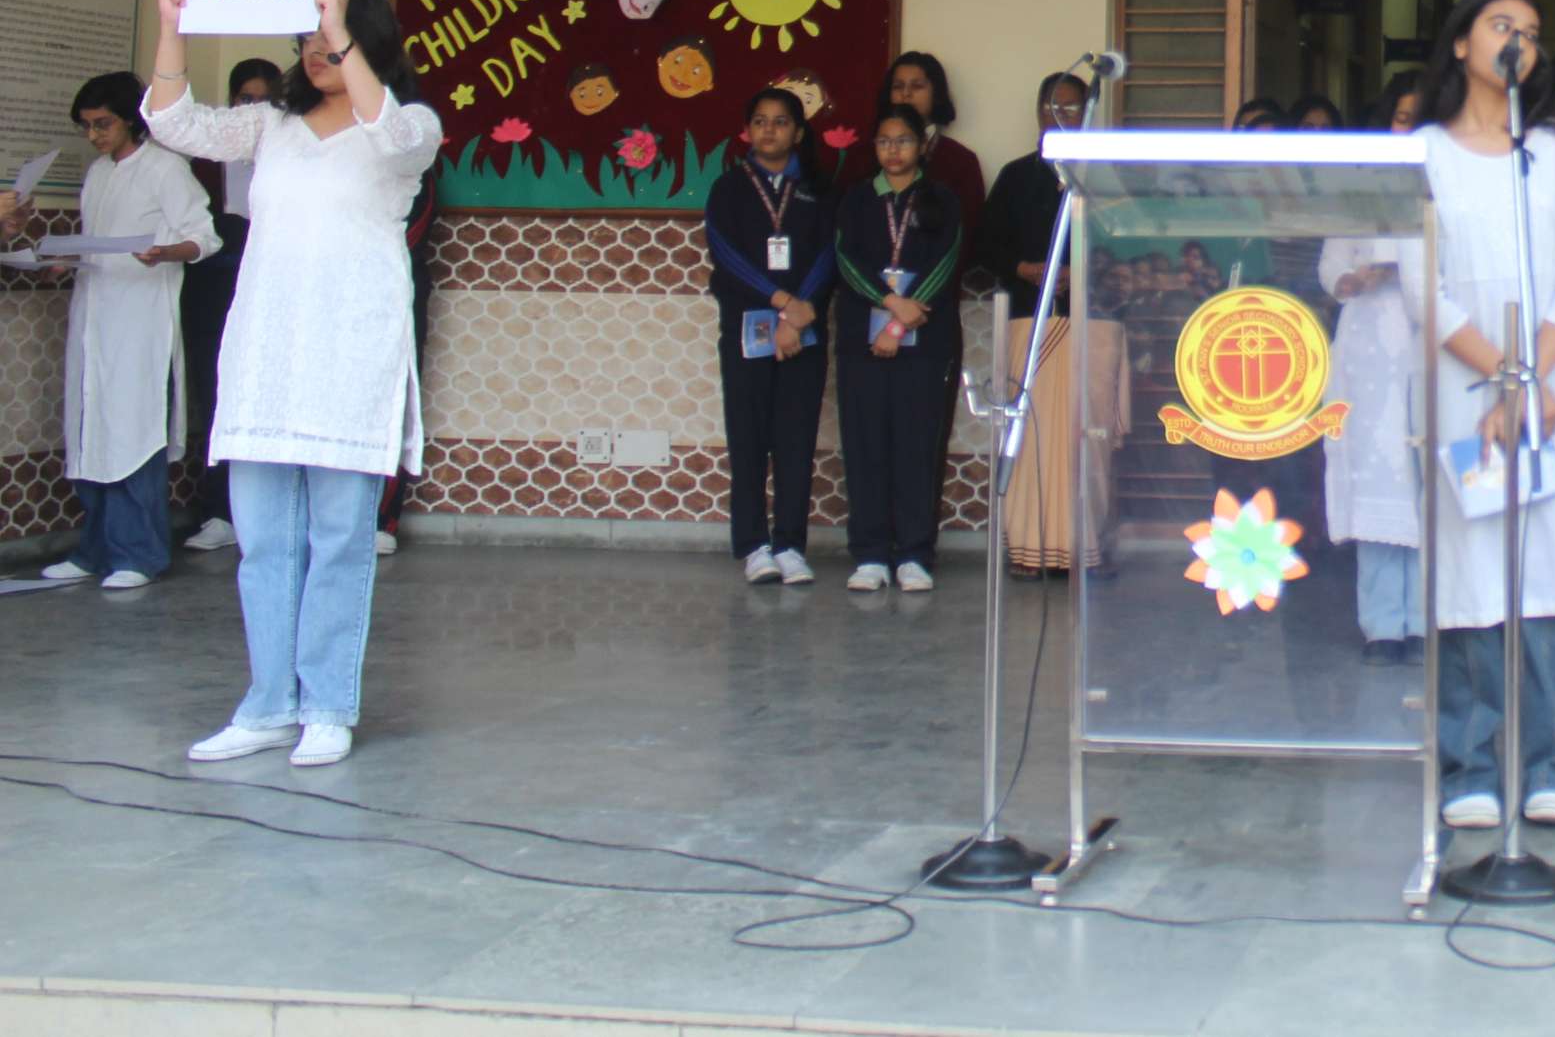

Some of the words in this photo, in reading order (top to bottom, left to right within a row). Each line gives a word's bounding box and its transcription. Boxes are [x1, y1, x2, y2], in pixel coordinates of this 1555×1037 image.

[481, 14, 561, 98] DAY
[1201, 431, 1231, 451] TRUTH
[1232, 441, 1255, 453] OUR
